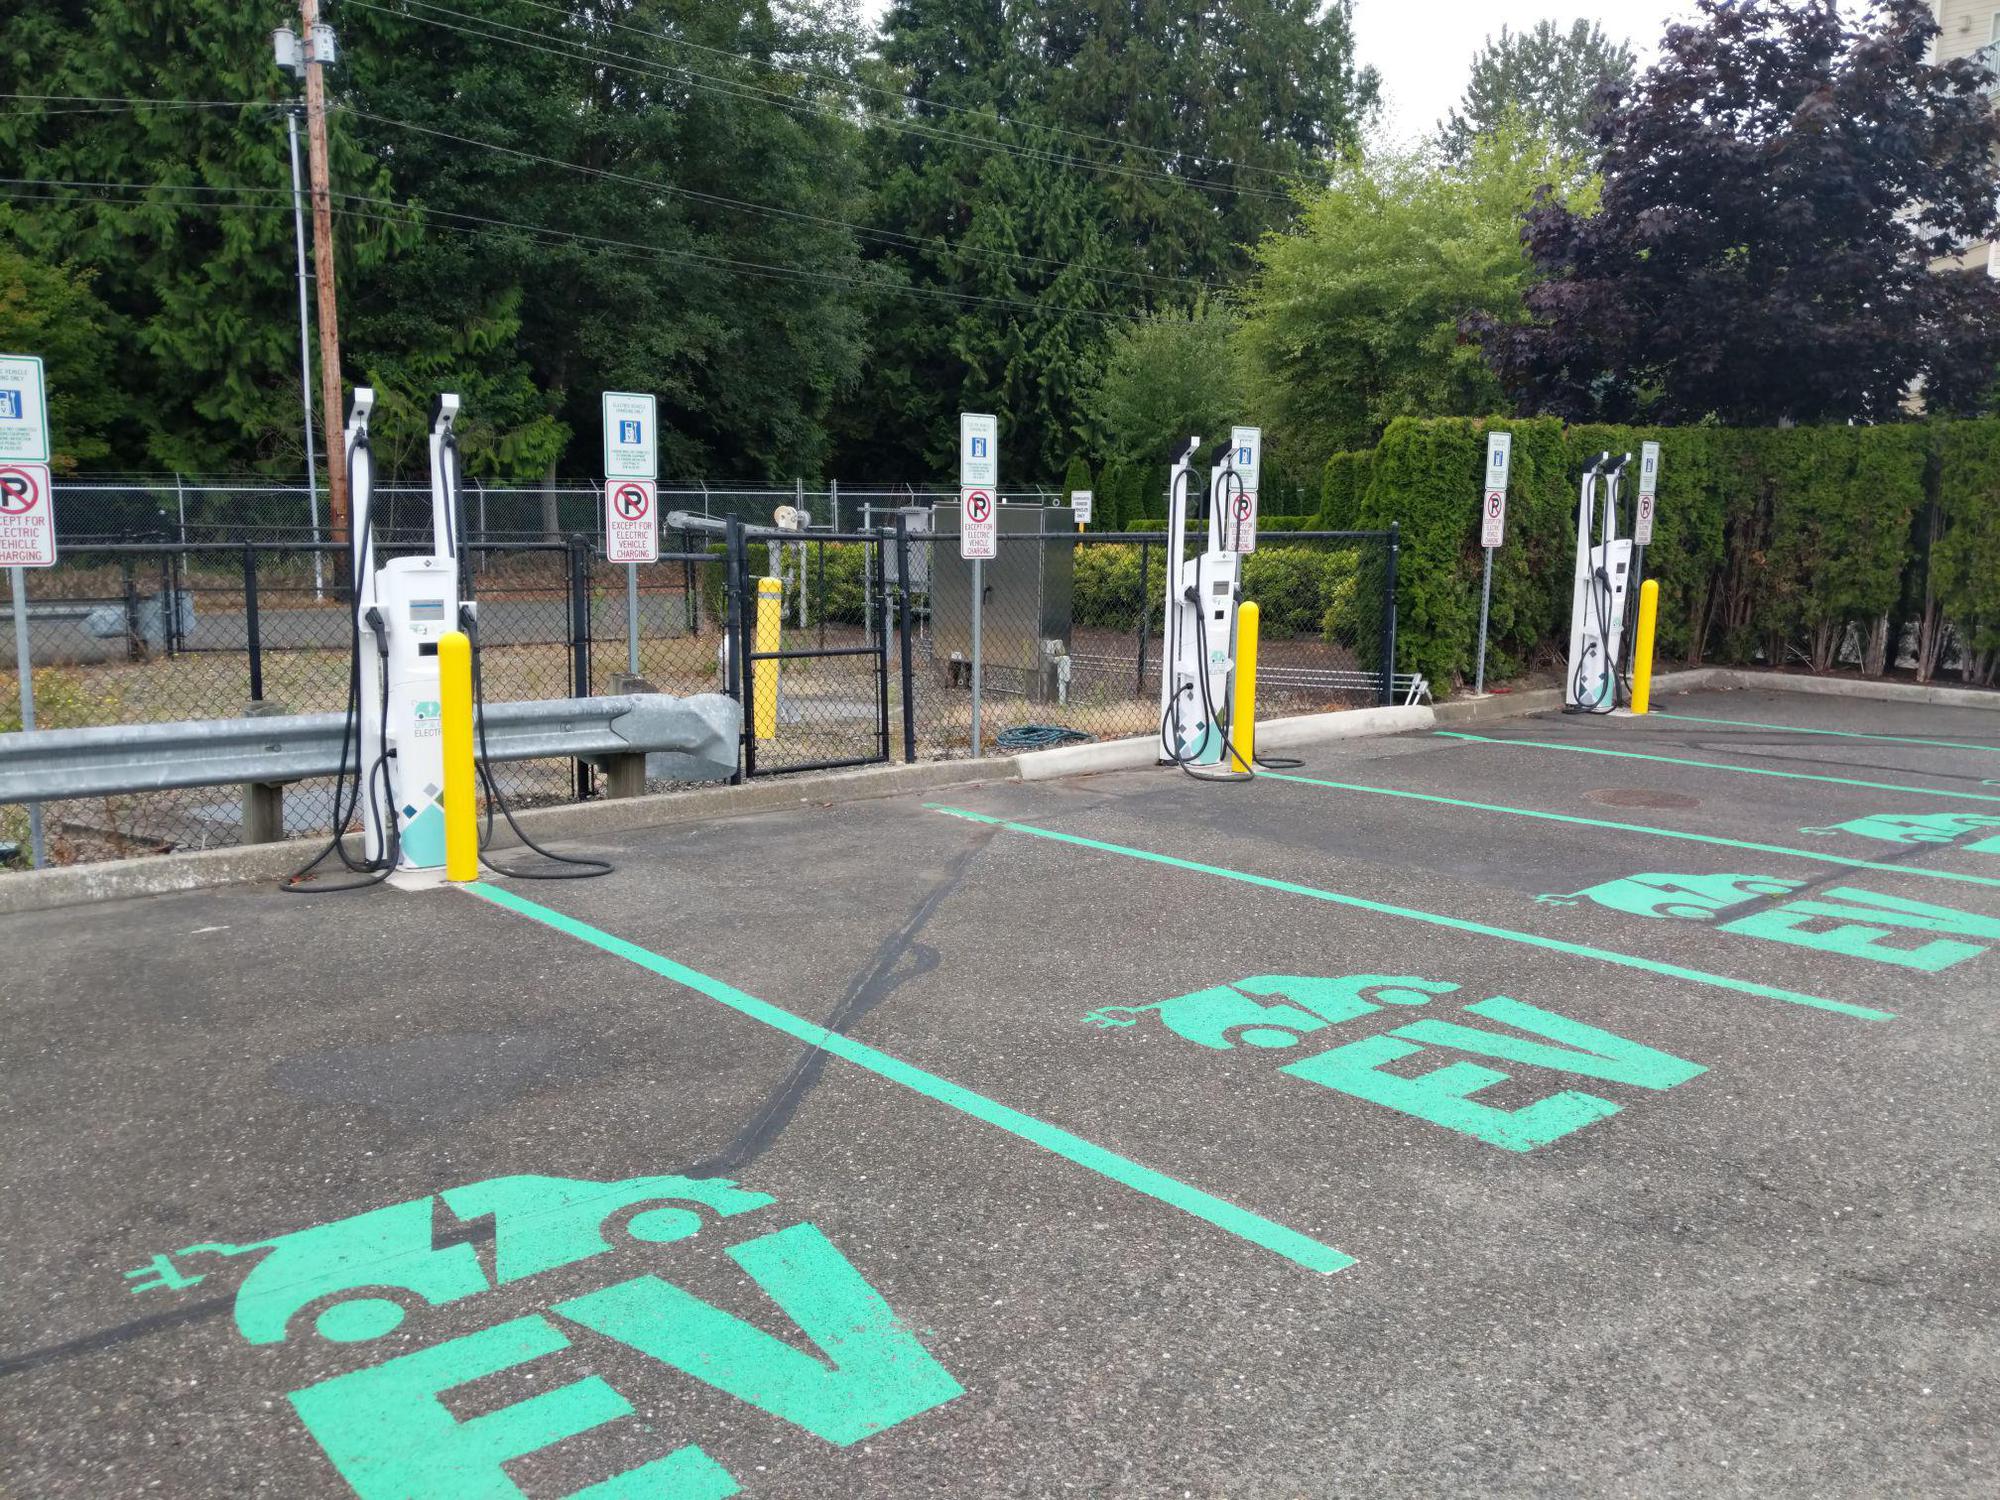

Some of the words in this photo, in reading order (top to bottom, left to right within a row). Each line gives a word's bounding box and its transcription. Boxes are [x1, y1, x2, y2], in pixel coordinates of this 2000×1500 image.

[25, 516, 45, 526] FOR
[612, 522, 637, 530] EXCEPT
[639, 522, 652, 530] FOR
[616, 531, 648, 539] ELECTRIC
[0, 539, 38, 549] EHICLE
[619, 541, 647, 549] VEHICLE
[616, 550, 650, 558] CHARGING
[1716, 887, 2000, 972] EV
[1278, 996, 1709, 1153] EV
[288, 1221, 966, 1500] EV
